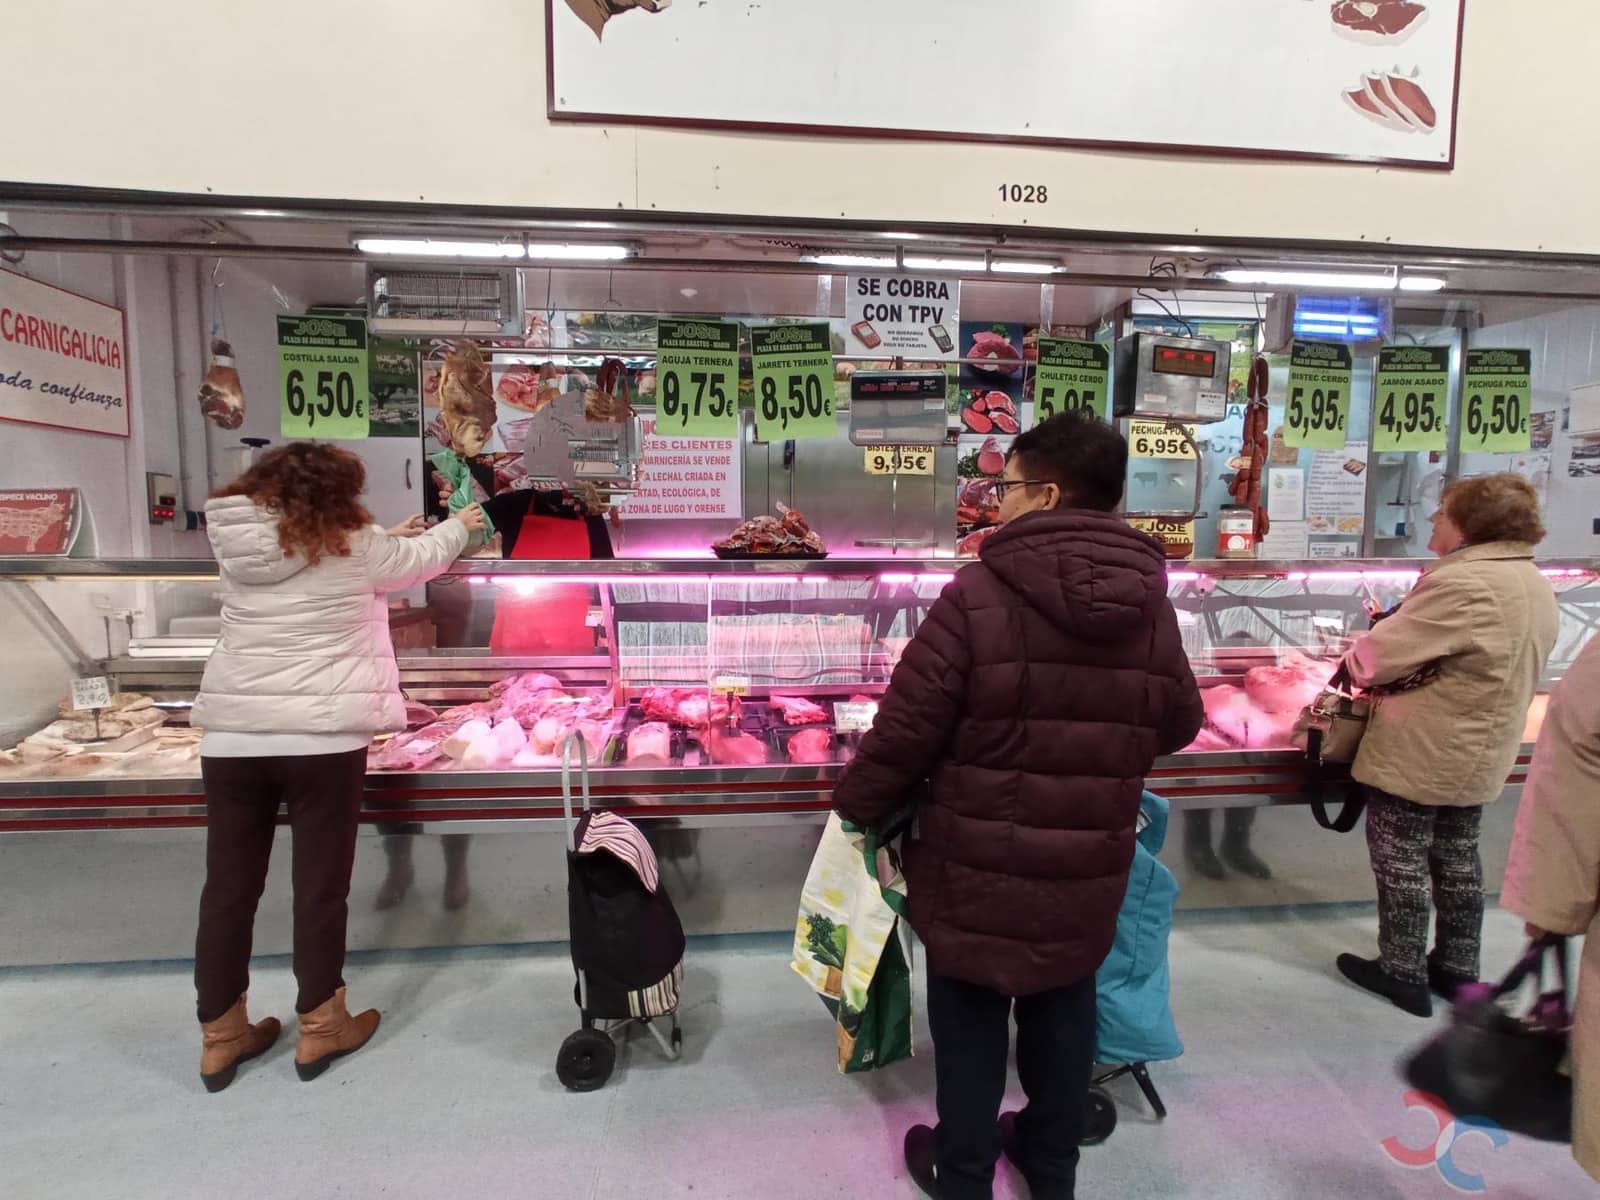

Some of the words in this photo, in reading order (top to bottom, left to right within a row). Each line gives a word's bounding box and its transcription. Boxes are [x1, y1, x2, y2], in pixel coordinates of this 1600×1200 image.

[998, 184, 1048, 204] 1028
[857, 278, 880, 296] SE
[887, 278, 949, 300] COBRA
[863, 304, 902, 322] CON
[908, 305, 944, 324] TPV
[1, 308, 121, 369] CARNIGALICIA
[283, 353, 325, 362] COSTILLA
[327, 355, 360, 363] SALADA
[662, 355, 691, 365] AGUJA
[694, 357, 733, 367] TERNERA
[757, 361, 791, 369] JARRETE
[794, 359, 829, 368] TERNERA
[1040, 372, 1077, 382] CHULETAS
[1080, 375, 1103, 384] CERDO
[1292, 372, 1319, 381] BISTEC
[1321, 375, 1349, 384] CERDO
[1381, 378, 1411, 386] JAMON
[1414, 378, 1445, 386] ASADO
[1468, 380, 1502, 388] PECHUGA
[1504, 380, 1528, 388] POLLO
[40, 382, 122, 410] confianza
[287, 370, 363, 428] 6,50€
[761, 374, 831, 431] 8,50€
[1289, 387, 1344, 438] 5,95€
[1380, 392, 1442, 443] 4,95€
[1467, 394, 1527, 444] 6,50€
[671, 440, 733, 450] CLIENTES
[1136, 438, 1189, 456] 6,95€
[693, 456, 704, 465] SE
[706, 456, 731, 465] VENDE
[652, 472, 684, 481] LECHAL
[685, 472, 713, 481] CRIADA
[716, 472, 726, 481] EN
[711, 488, 721, 497] DE
[628, 504, 650, 514] ZONA
[652, 505, 662, 514] DE
[664, 504, 685, 513] LUGO
[687, 504, 694, 513] Y
[695, 504, 726, 513] ORENSE
